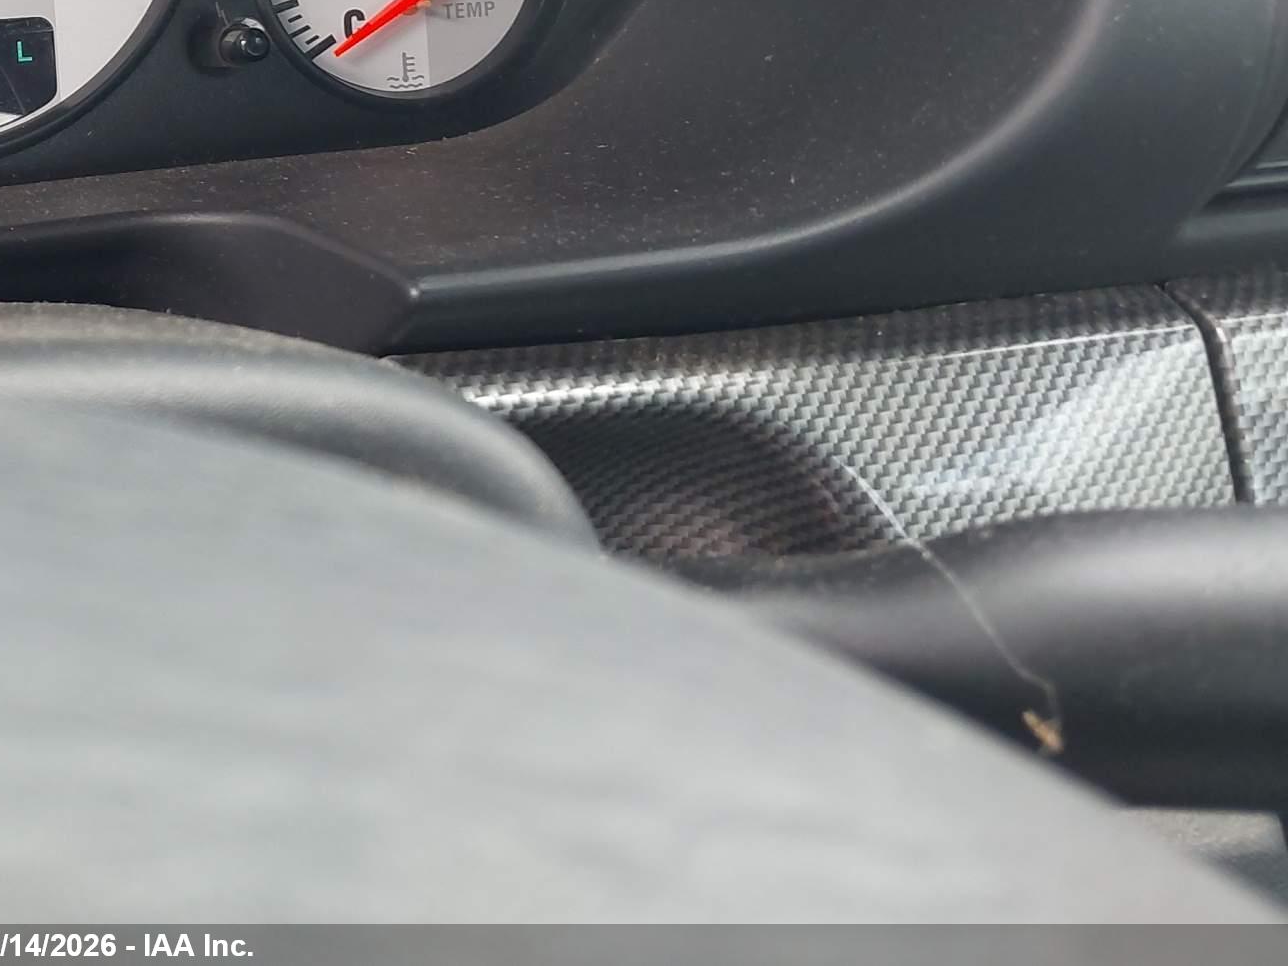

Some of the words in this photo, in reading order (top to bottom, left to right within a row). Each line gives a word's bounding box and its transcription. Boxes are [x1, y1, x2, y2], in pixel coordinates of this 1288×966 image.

[442, 0, 497, 21] TEMP
[343, 8, 367, 38] C
[16, 40, 34, 63] L
